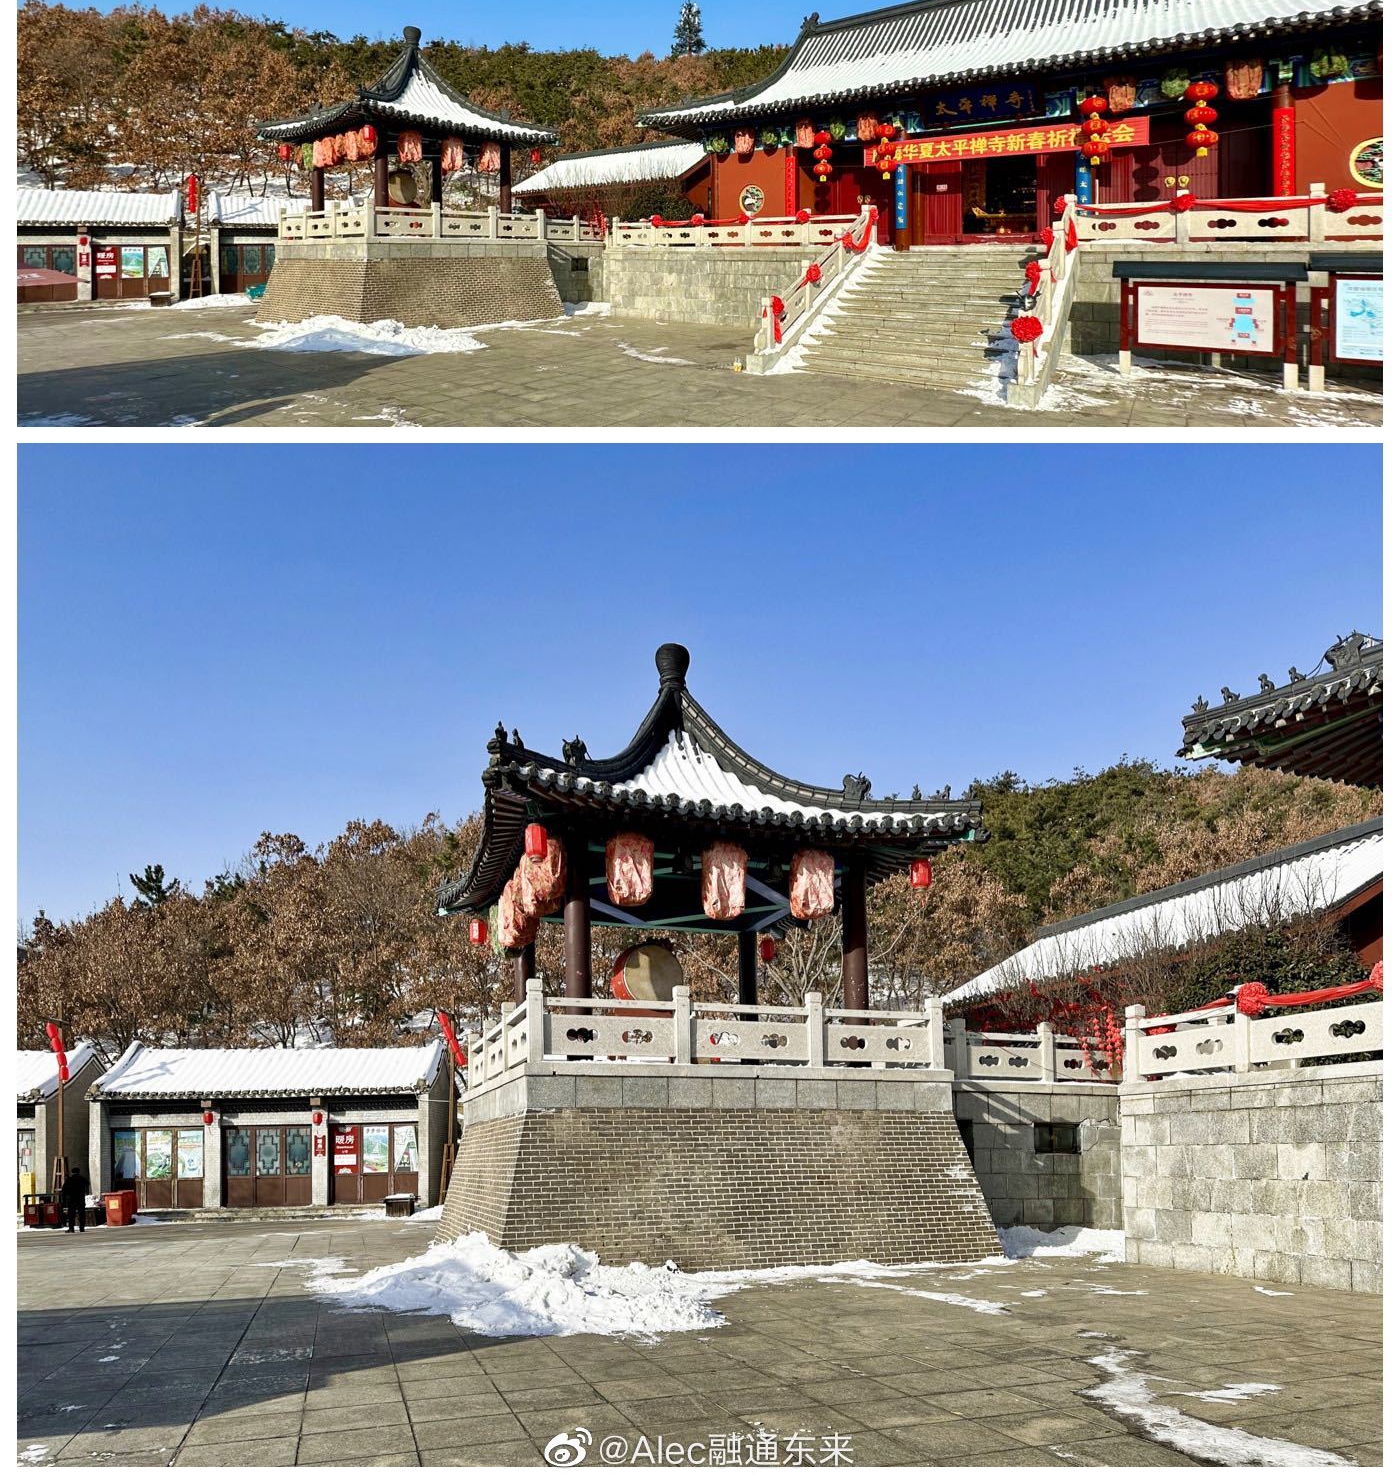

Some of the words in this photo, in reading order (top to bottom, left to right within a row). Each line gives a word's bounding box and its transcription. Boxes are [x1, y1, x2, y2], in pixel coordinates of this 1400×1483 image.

[872, 124, 1135, 163] 海华夏太平禅寺新春祈会
[335, 1135, 354, 1144] 暖房
